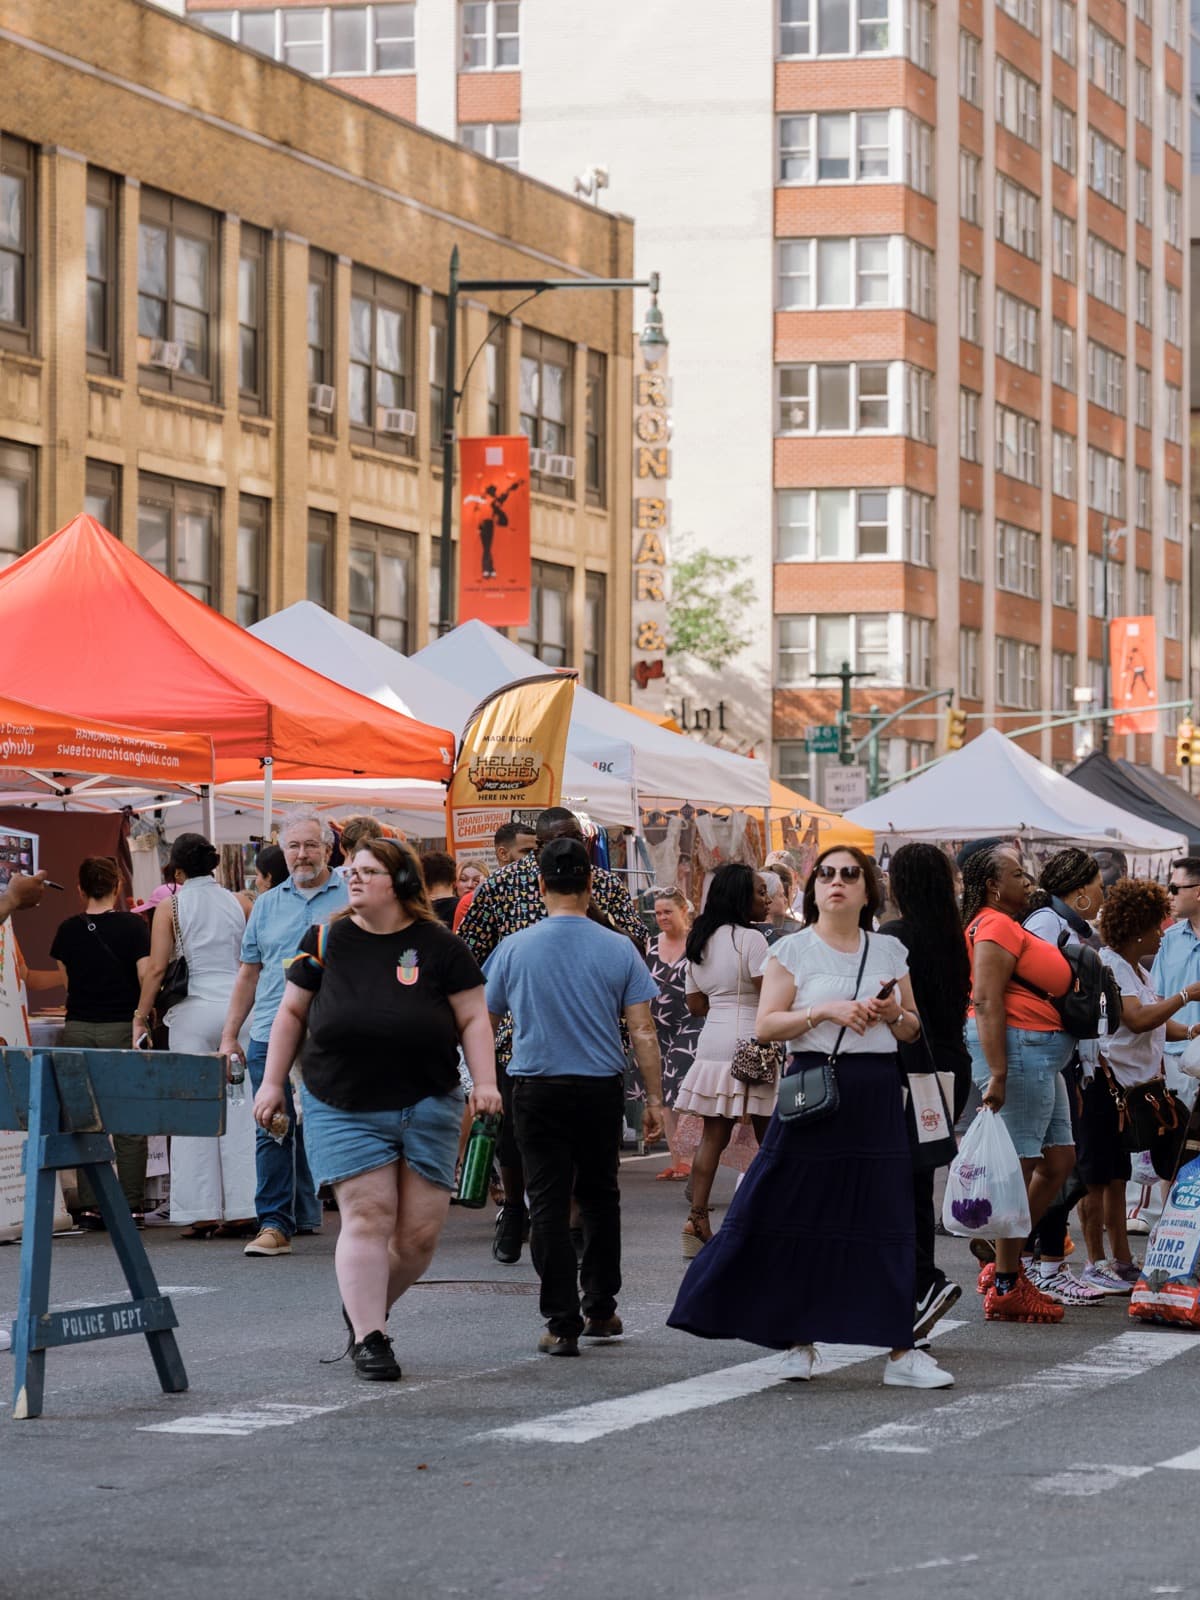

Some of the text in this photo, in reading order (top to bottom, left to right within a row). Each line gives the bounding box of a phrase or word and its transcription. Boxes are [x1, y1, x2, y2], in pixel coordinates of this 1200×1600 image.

[635, 361, 668, 651] RON BAR &
[0, 737, 35, 760] ghulu
[57, 742, 180, 767] sweetcrunchtanghulu.com
[476, 756, 535, 767] HELL'S
[468, 767, 541, 778] KITCHEN
[510, 793, 526, 801] NYC
[457, 815, 482, 826] GRAND
[457, 821, 505, 838] CHAMPIO
[1152, 1237, 1186, 1253] UMP
[1146, 1253, 1186, 1270] HARCOAL
[62, 1307, 148, 1337] POLICE DEPT.
